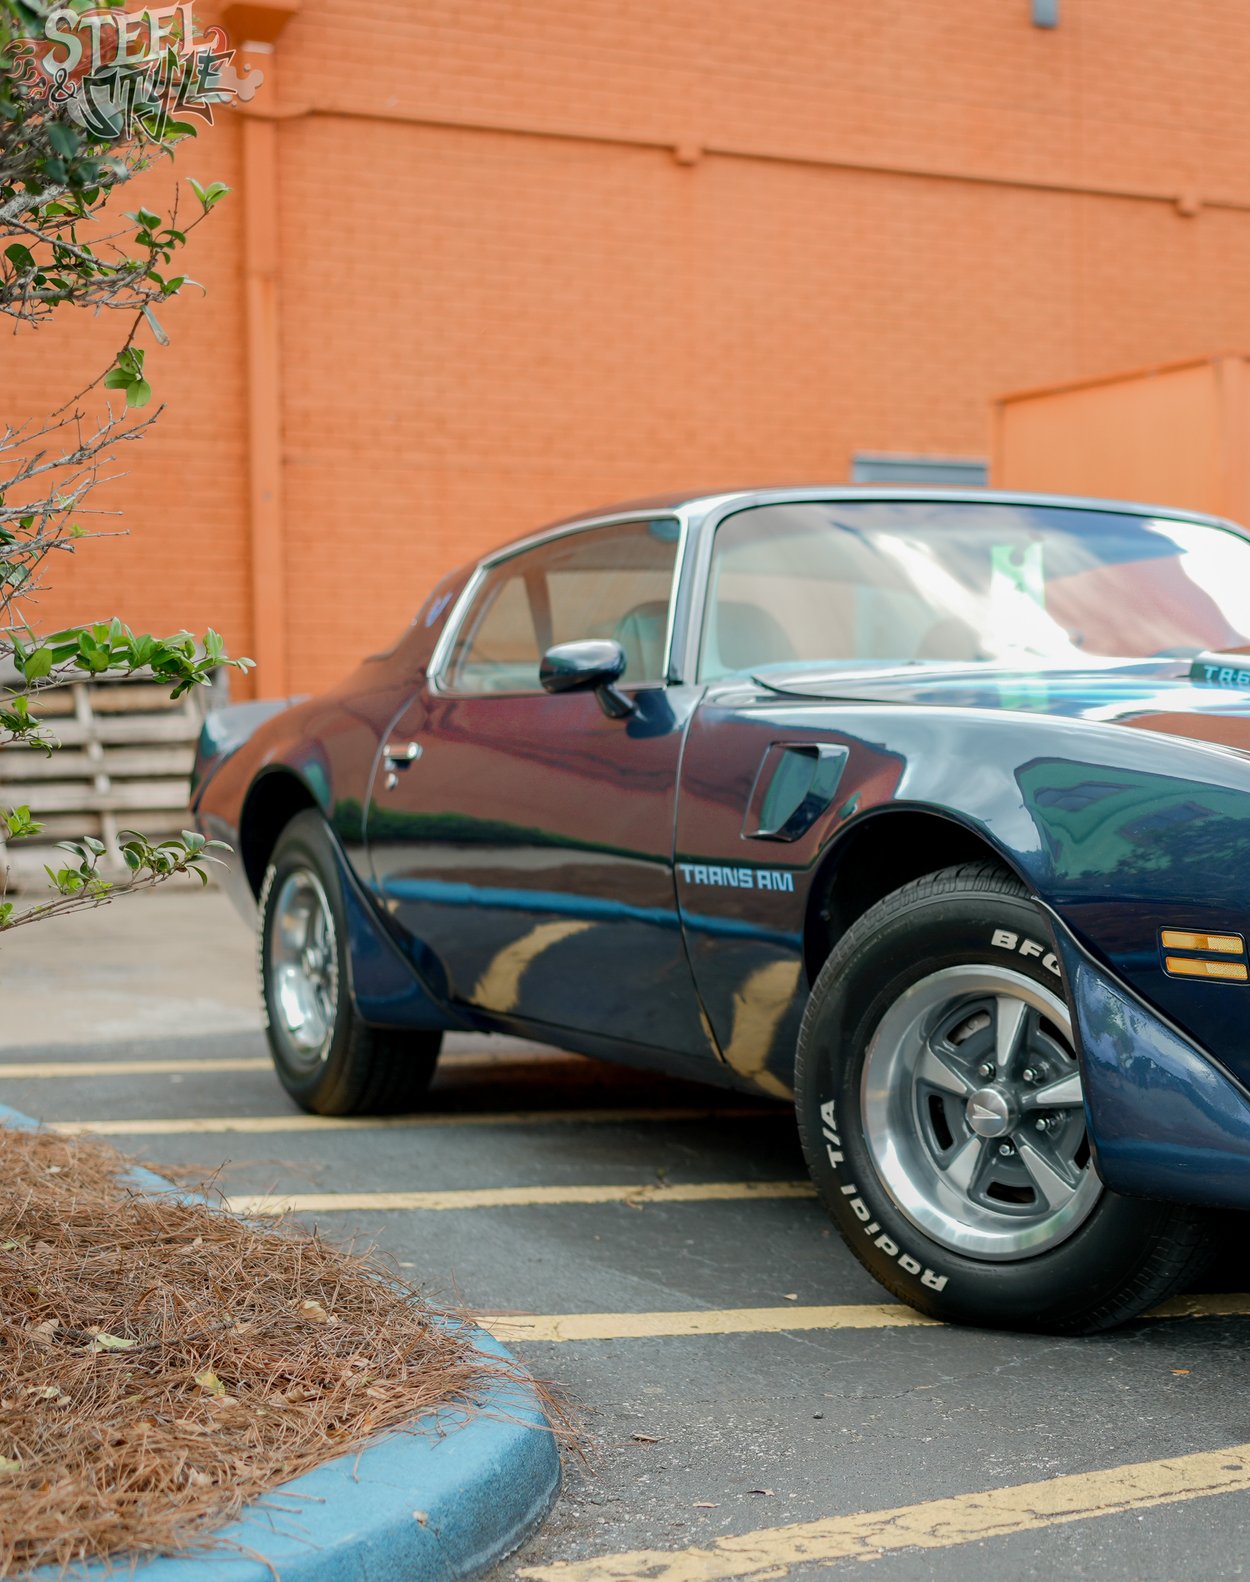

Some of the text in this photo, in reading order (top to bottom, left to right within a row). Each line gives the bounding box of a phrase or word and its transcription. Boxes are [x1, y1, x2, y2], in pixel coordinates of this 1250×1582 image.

[679, 863, 794, 892] TRANS AM
[820, 1100, 949, 1292] Radial T/A
